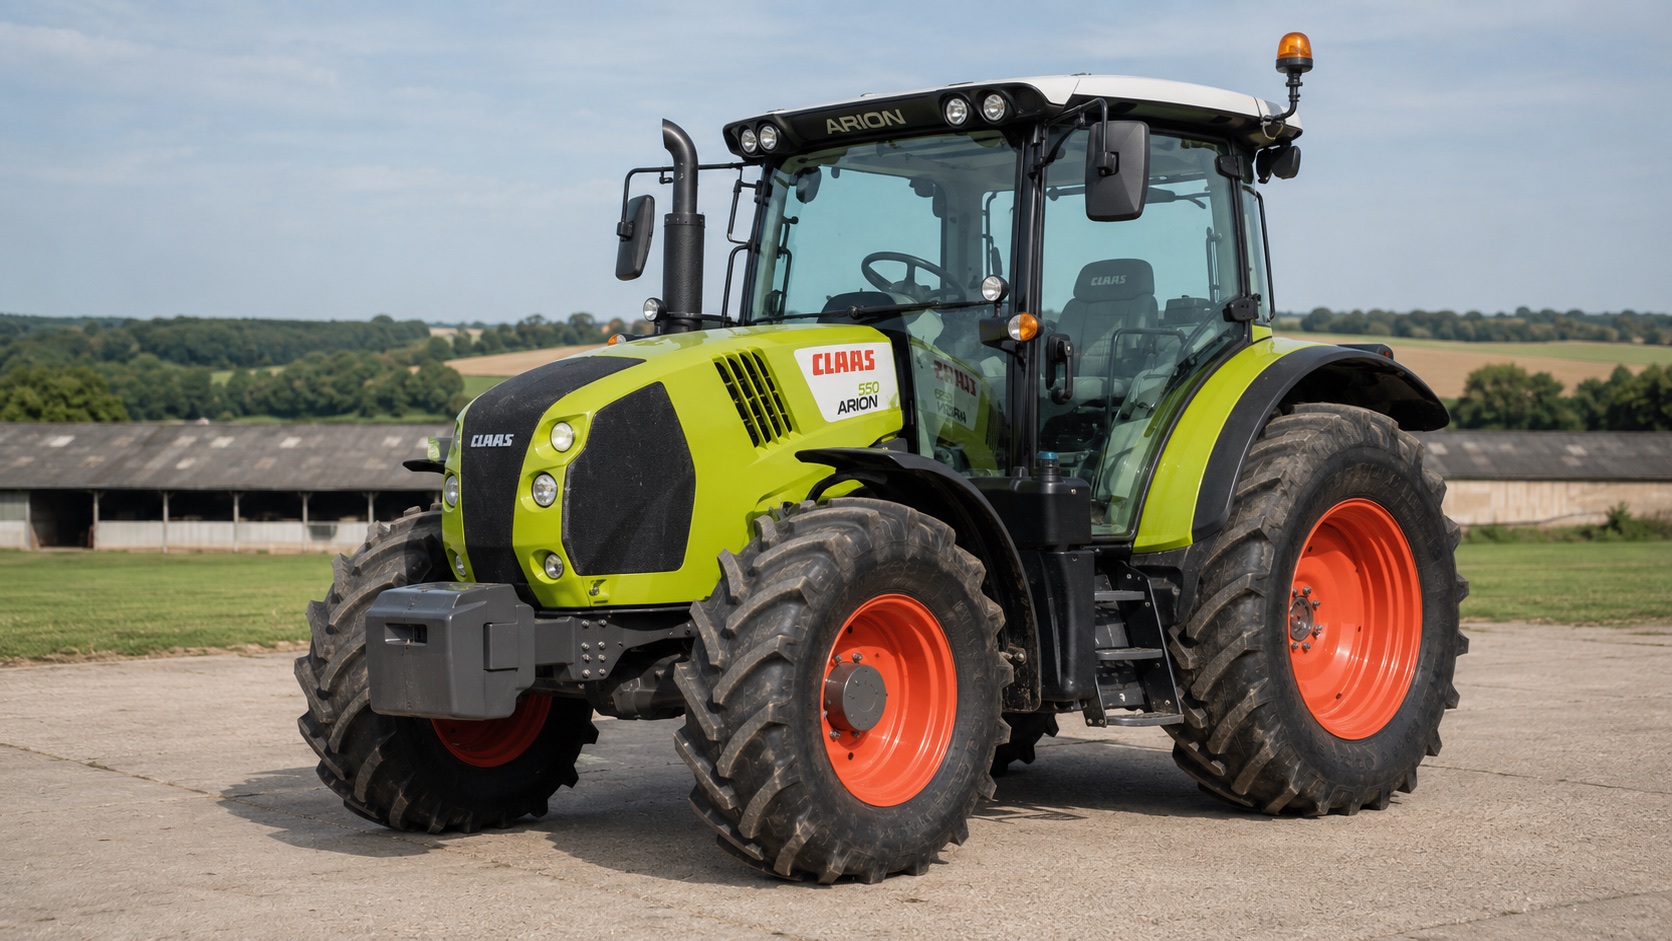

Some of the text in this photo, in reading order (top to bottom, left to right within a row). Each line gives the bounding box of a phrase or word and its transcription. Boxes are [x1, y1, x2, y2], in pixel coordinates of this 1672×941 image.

[826, 109, 907, 135] ARION
[1090, 274, 1127, 286] CLAAS
[812, 349, 875, 376] CLAAS
[858, 381, 880, 396] 550
[837, 395, 878, 415] ARION
[470, 433, 515, 447] CLAAS
